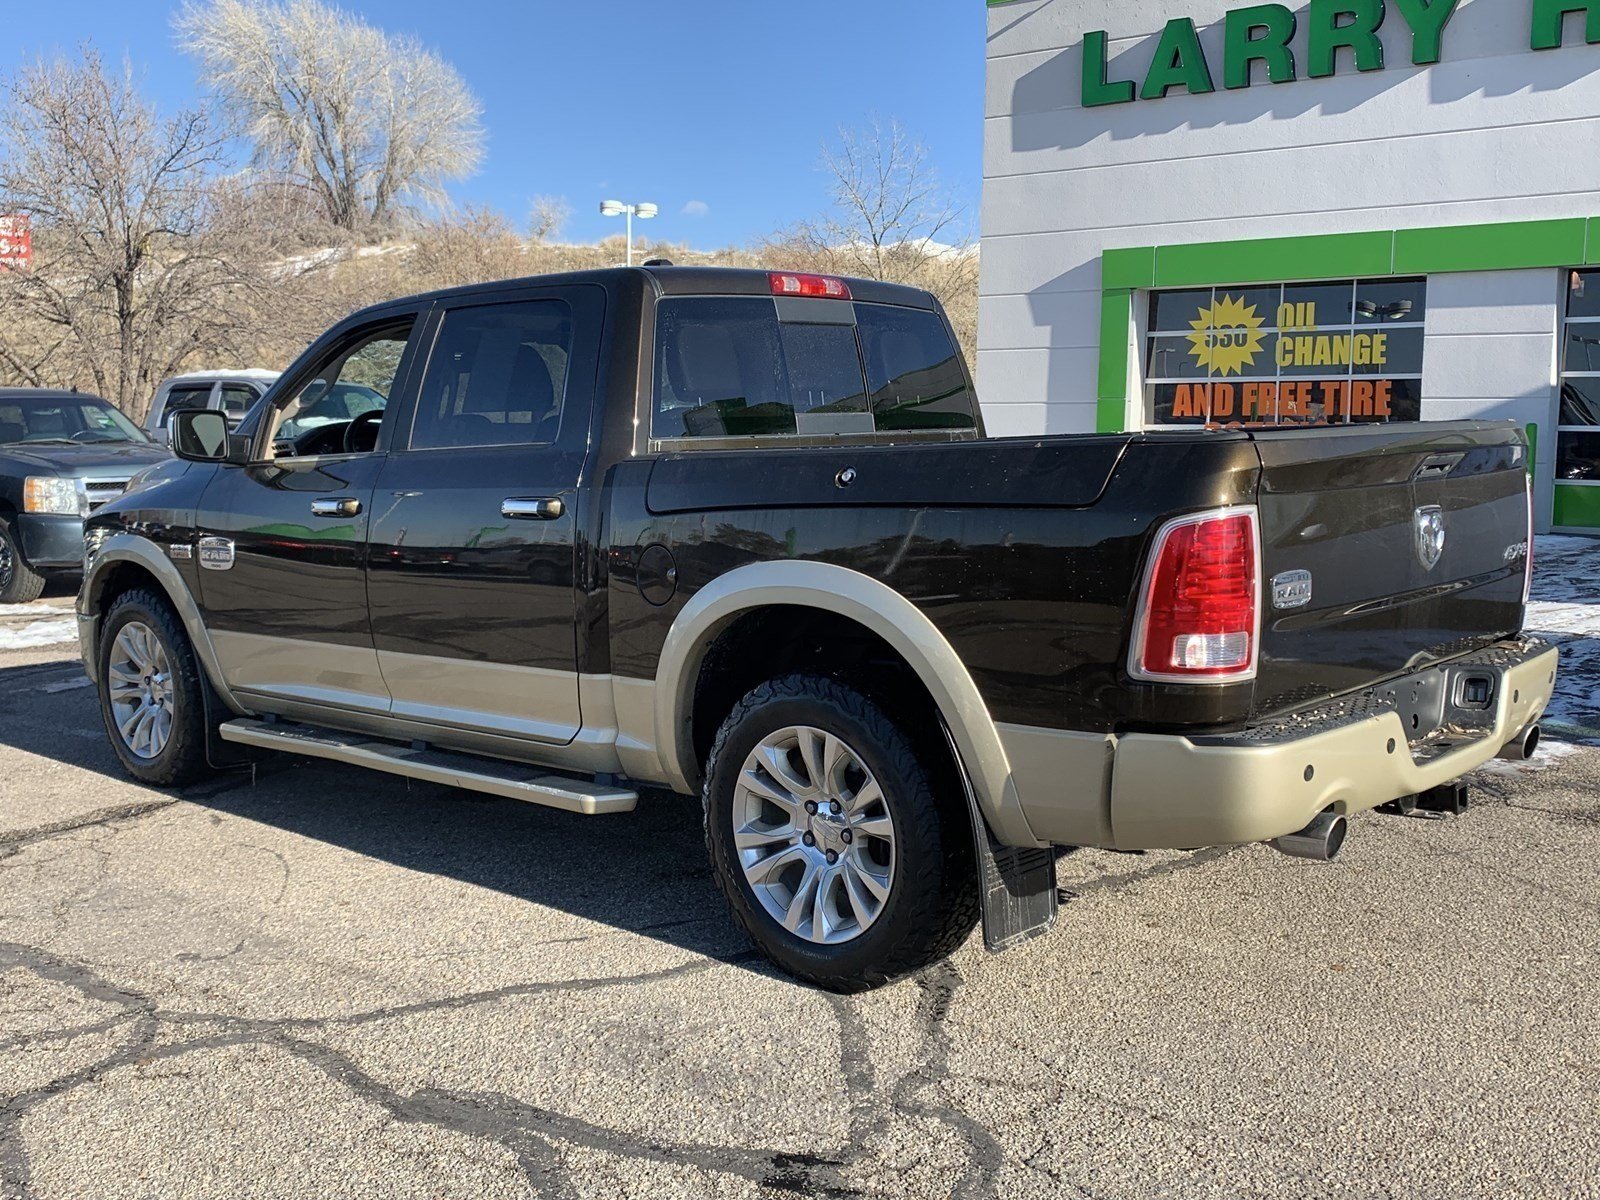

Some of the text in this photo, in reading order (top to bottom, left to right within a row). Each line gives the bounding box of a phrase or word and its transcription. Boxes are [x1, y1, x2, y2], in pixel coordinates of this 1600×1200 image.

[1081, 0, 1459, 107] LARRY
[1276, 302, 1316, 331] OIL
[1275, 333, 1387, 367] CHANGE
[1172, 380, 1392, 417] AND FREE TIRE
[201, 550, 231, 560] RAM
[1275, 584, 1310, 600] RAM
